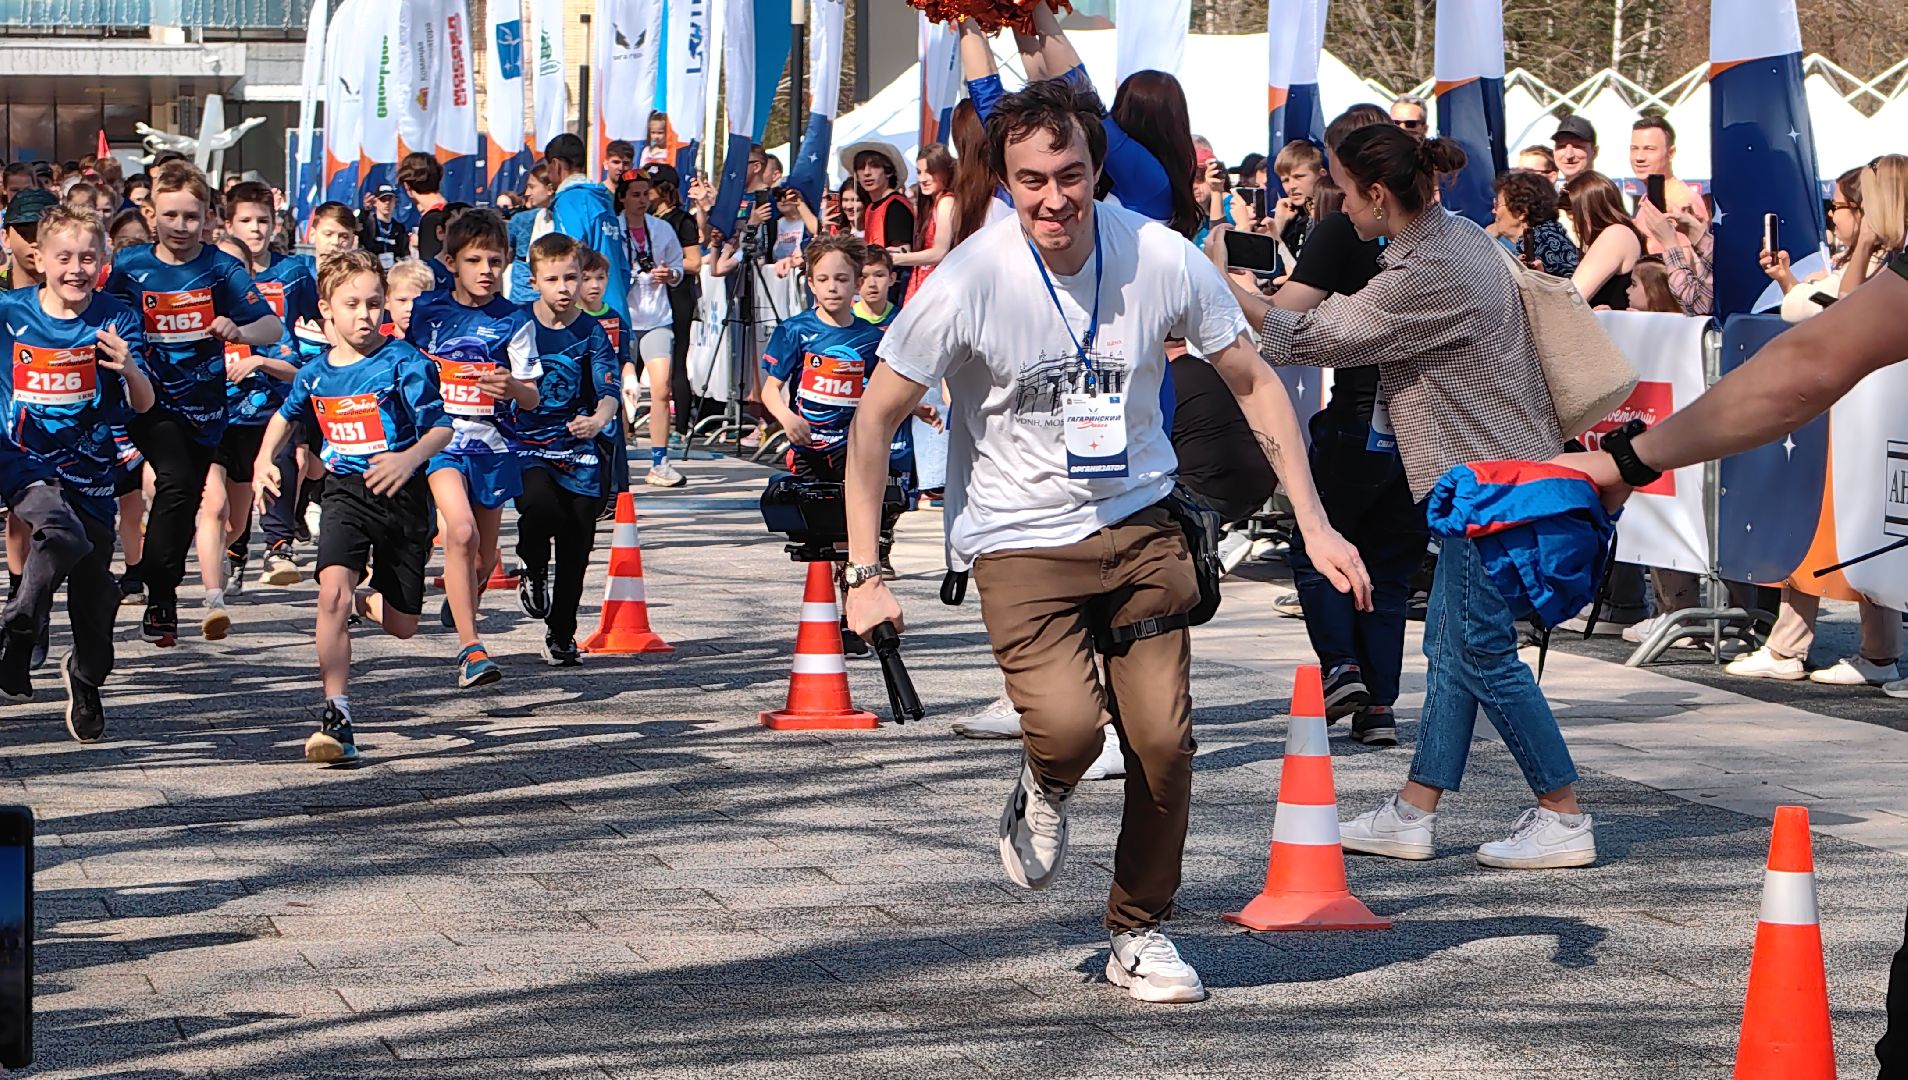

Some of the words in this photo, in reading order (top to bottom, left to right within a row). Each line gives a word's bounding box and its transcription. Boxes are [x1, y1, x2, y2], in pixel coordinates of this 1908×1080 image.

[155, 312, 203, 330] 2162
[27, 371, 82, 391] 2126
[812, 376, 853, 395] 2114
[1067, 415, 1121, 423] ГАГАРИНСКИЙ
[327, 421, 367, 441] 2131
[1070, 464, 1127, 473] ОРГАНИЗАТОР
